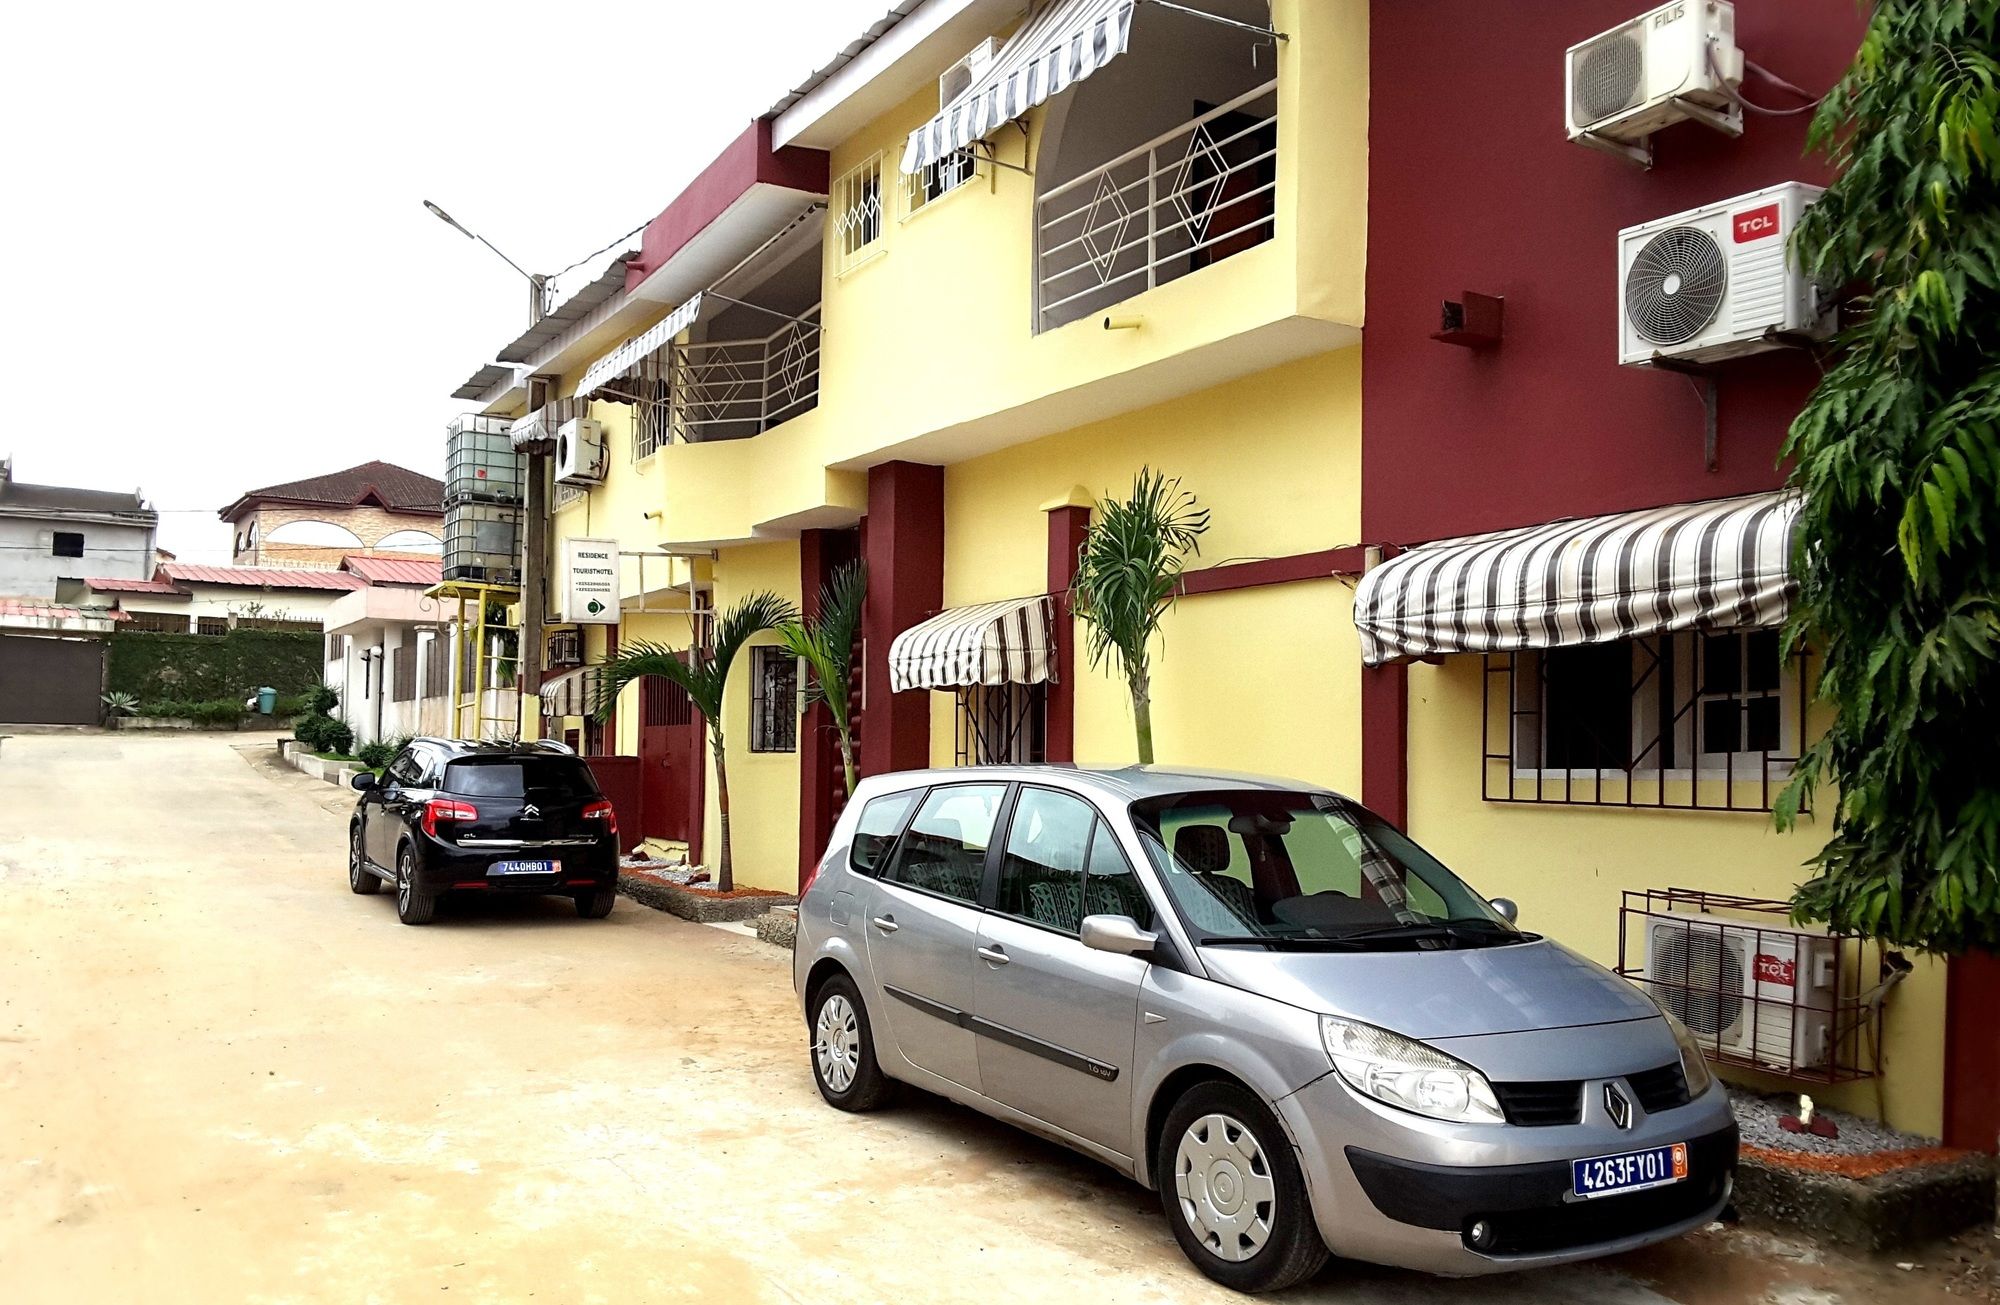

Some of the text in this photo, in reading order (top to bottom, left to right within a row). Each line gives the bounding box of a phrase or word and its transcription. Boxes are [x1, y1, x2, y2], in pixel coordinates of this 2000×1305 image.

[1655, 4, 1685, 28] FILIS
[1739, 216, 1773, 233] TCL
[503, 862, 548, 872] 7440HB01
[1759, 961, 1789, 977] TCL
[1583, 1151, 1665, 1189] 4263FY01
